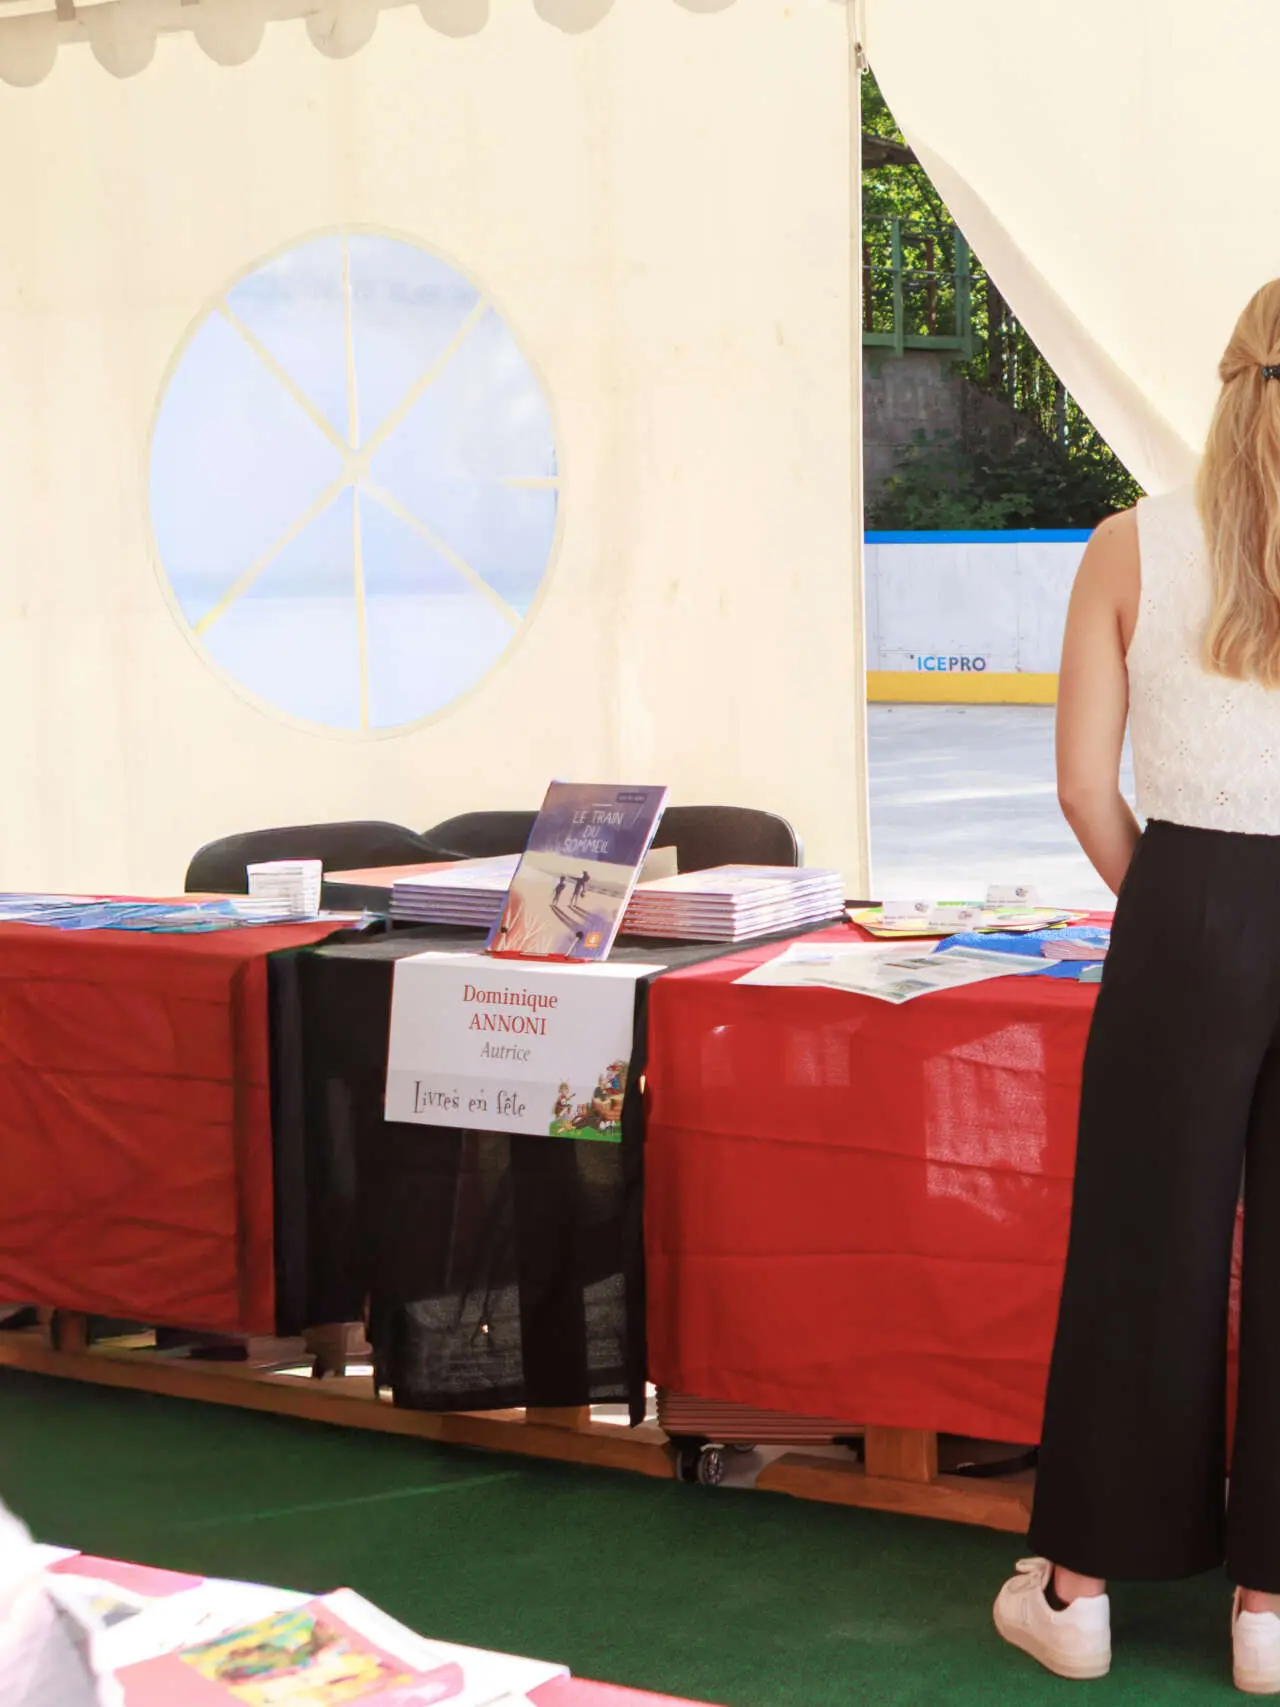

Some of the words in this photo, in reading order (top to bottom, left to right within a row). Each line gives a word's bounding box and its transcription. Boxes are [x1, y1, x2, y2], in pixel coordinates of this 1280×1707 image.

[917, 655, 986, 671] ICEPRO
[572, 810, 587, 824] LE
[590, 811, 624, 825] TRAIN
[583, 825, 600, 838] DU
[564, 838, 609, 854] SOMMEIL
[463, 984, 558, 1012] Dominique
[468, 1013, 547, 1036] ANNONI
[480, 1041, 531, 1062] Autrice
[412, 1080, 460, 1114] Livres
[468, 1088, 487, 1112] en
[496, 1090, 527, 1117] fête
